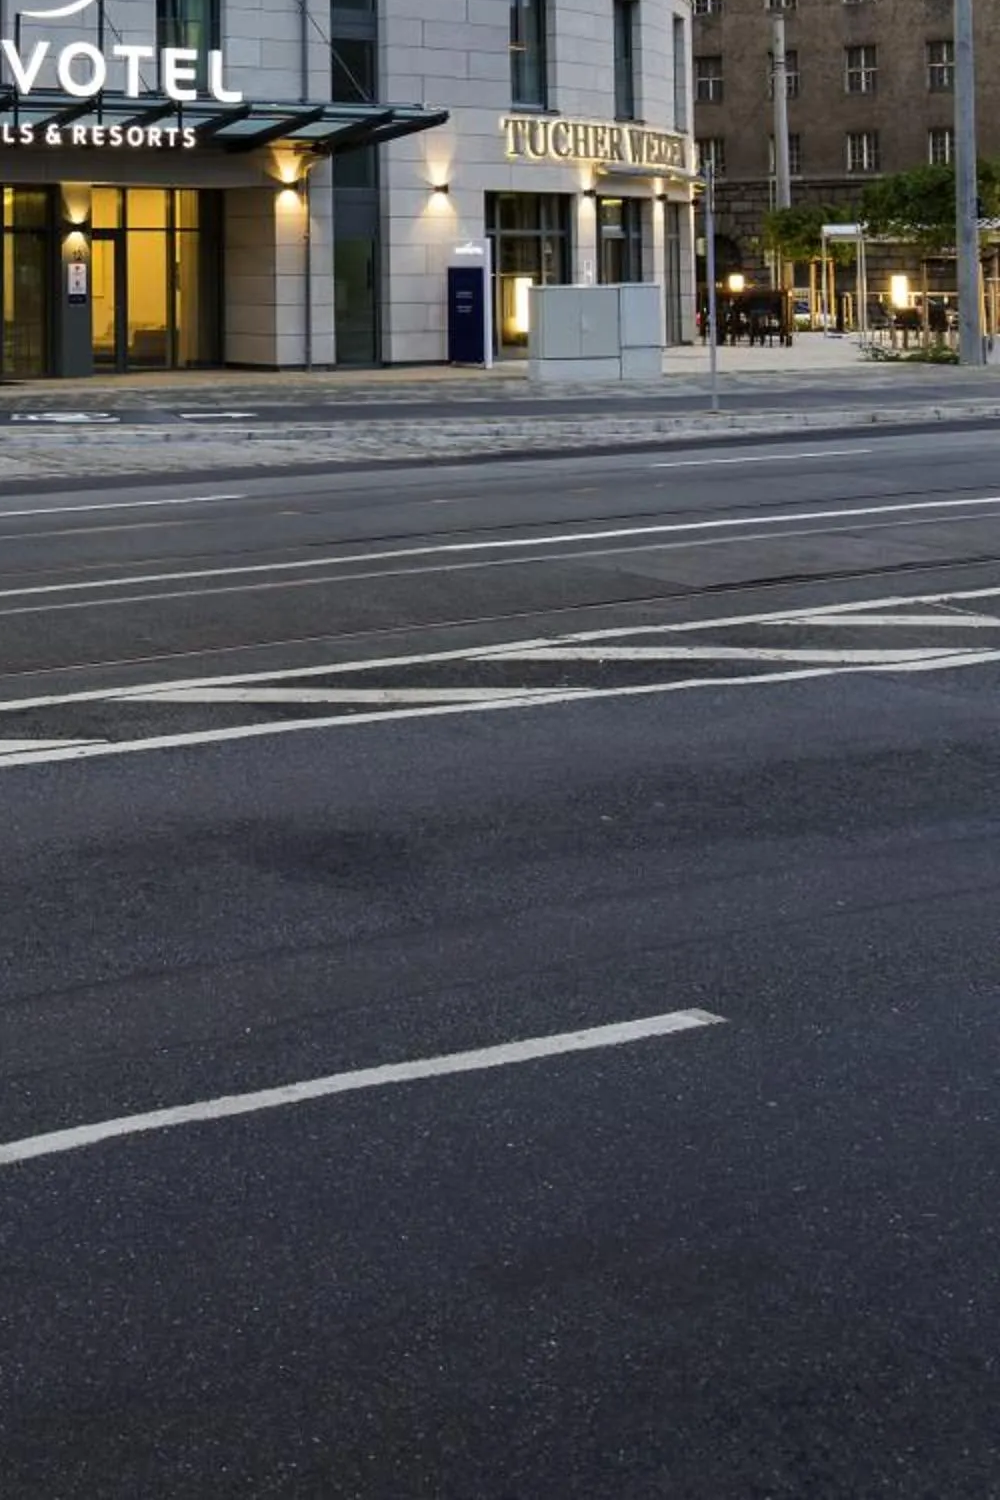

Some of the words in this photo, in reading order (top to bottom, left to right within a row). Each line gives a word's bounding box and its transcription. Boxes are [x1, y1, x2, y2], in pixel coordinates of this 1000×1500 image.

[45, 123, 62, 146] &
[72, 125, 197, 149] RESORTS
[503, 119, 624, 161] TUCHER
